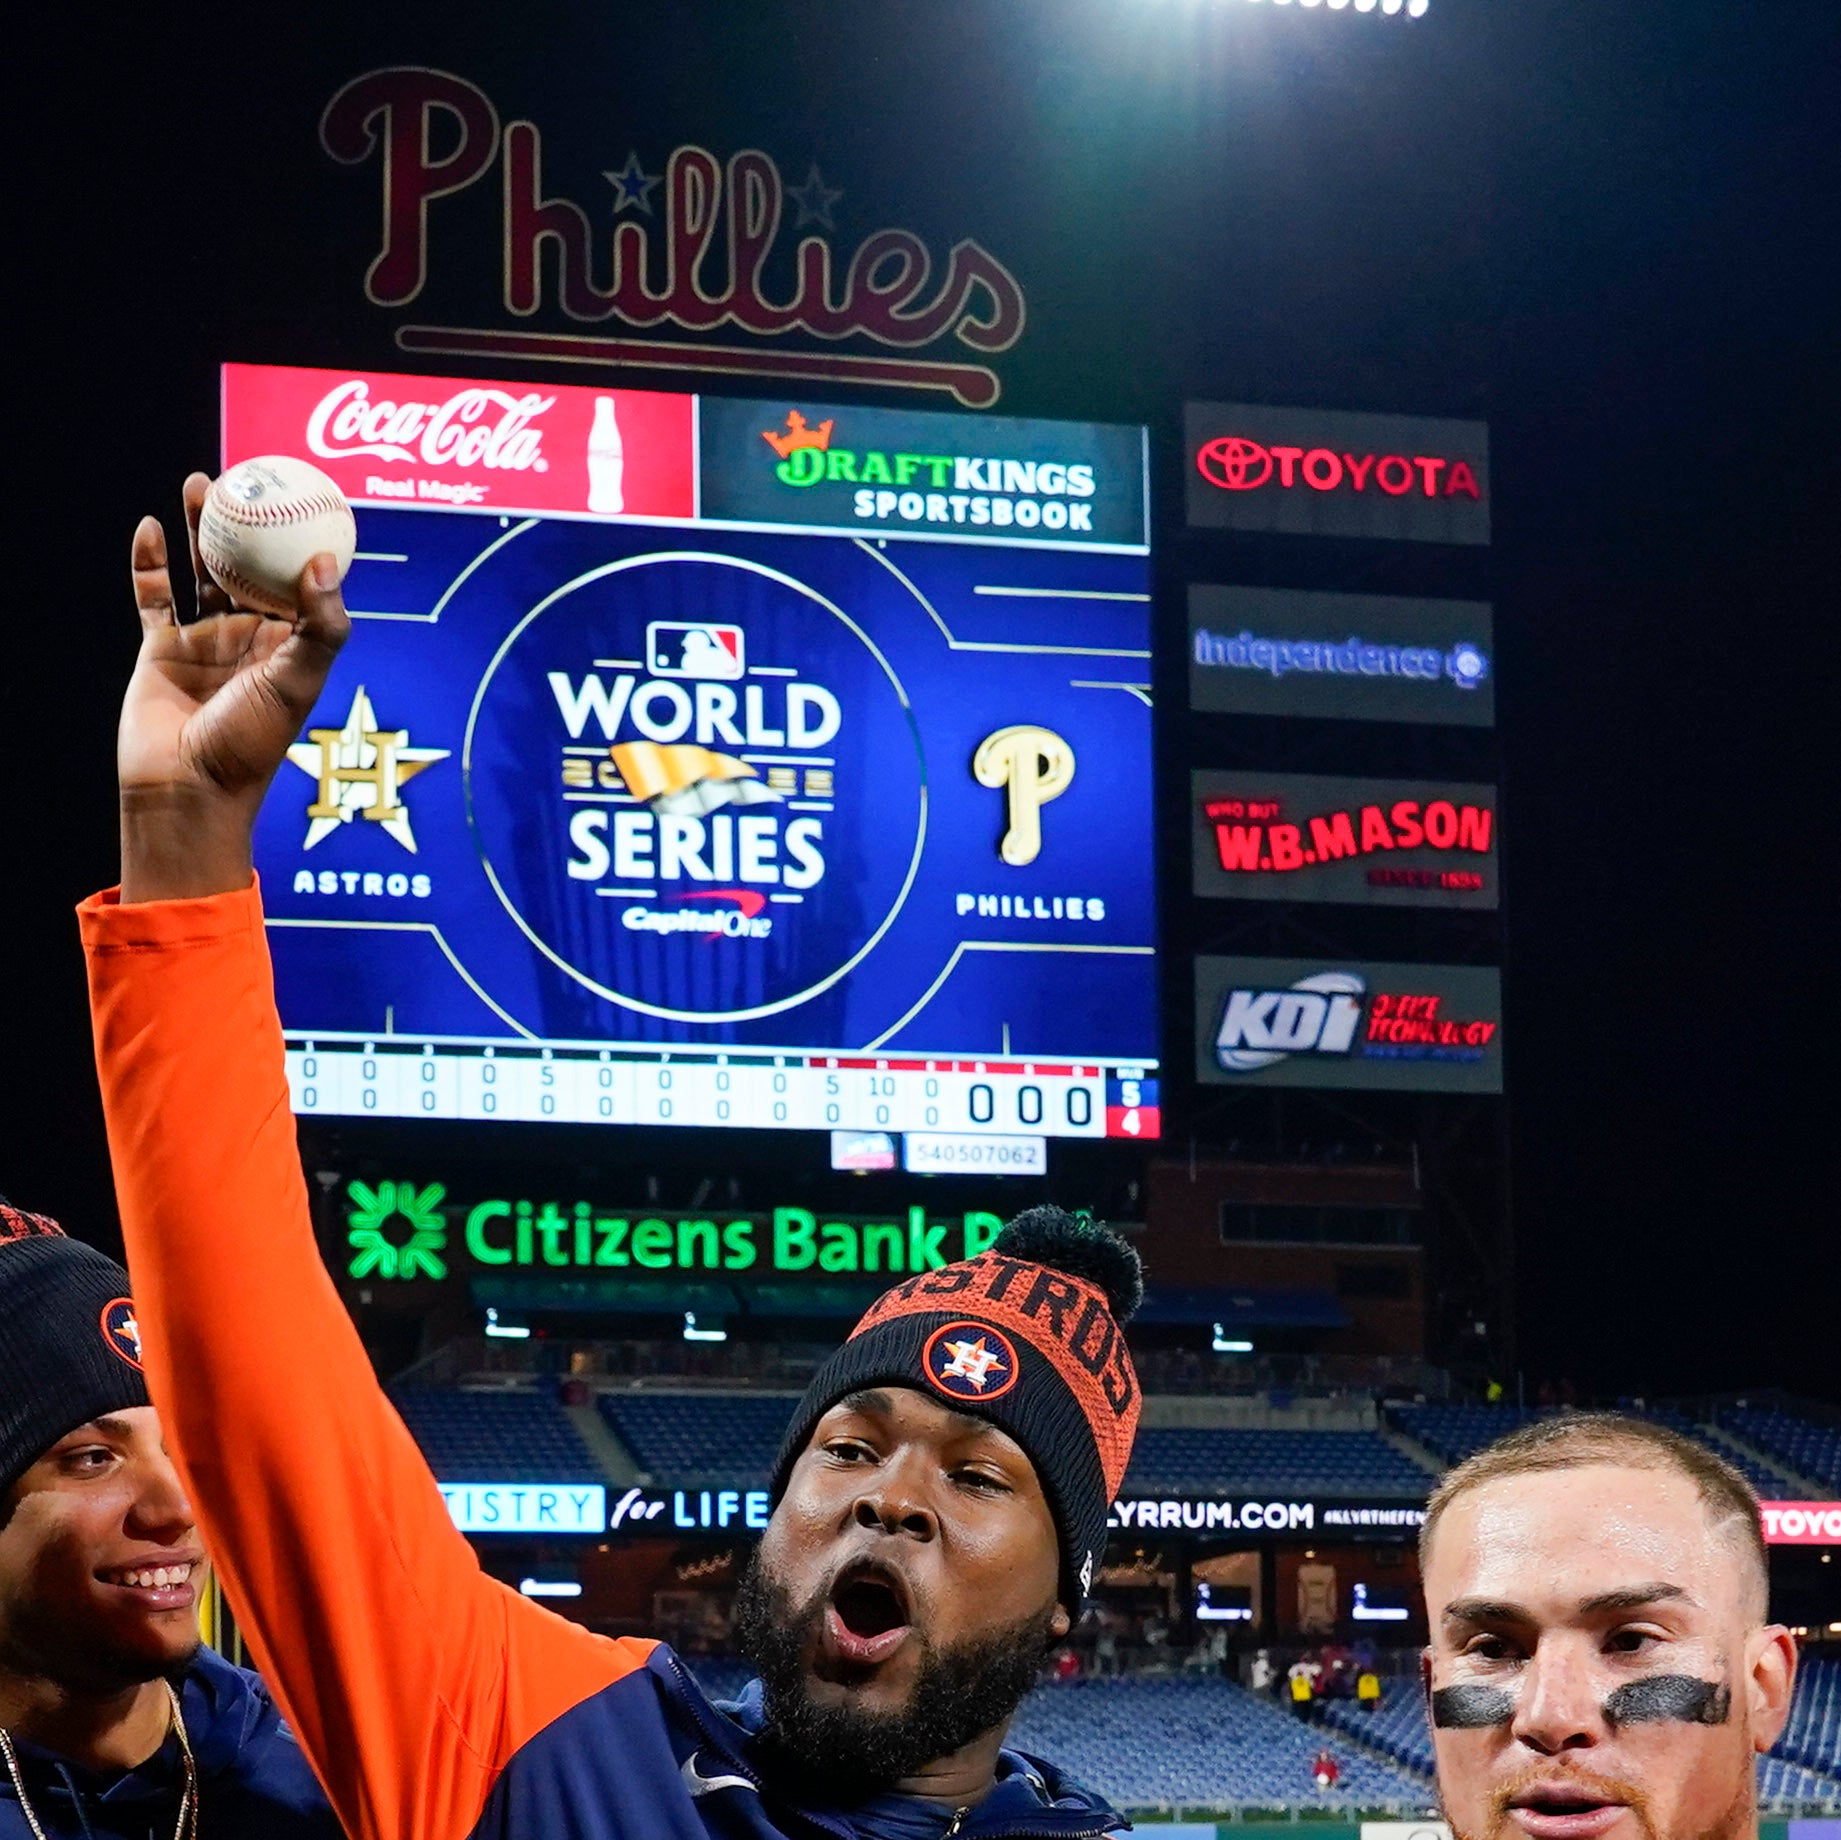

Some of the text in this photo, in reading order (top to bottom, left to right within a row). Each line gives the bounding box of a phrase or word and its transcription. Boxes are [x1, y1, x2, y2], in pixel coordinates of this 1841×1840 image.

[319, 66, 1026, 353] Phillies
[306, 379, 556, 472] Coca-Cola
[366, 475, 484, 504] Real Magic
[776, 447, 1096, 498] DRAFTKINGS
[1269, 446, 1481, 499] TOYOTA
[854, 489, 1093, 531] SPORTSBOOK
[547, 671, 842, 749] WORLD
[567, 808, 826, 889] SERIES
[293, 869, 432, 898] ASTROS
[955, 893, 1106, 922] PHILLIES
[303, 1058, 938, 1098] 0 0 0 0 5 0 0 0 0 5 10 0
[303, 1087, 938, 1126] 0 0 0 0 0 0 0 0 0 0 0 0
[969, 1084, 1091, 1126] 0 0 0
[465, 1201, 757, 1270] Citizens
[773, 1205, 947, 1273] Bank
[610, 1488, 665, 1529] for
[674, 1490, 769, 1528] LIFE
